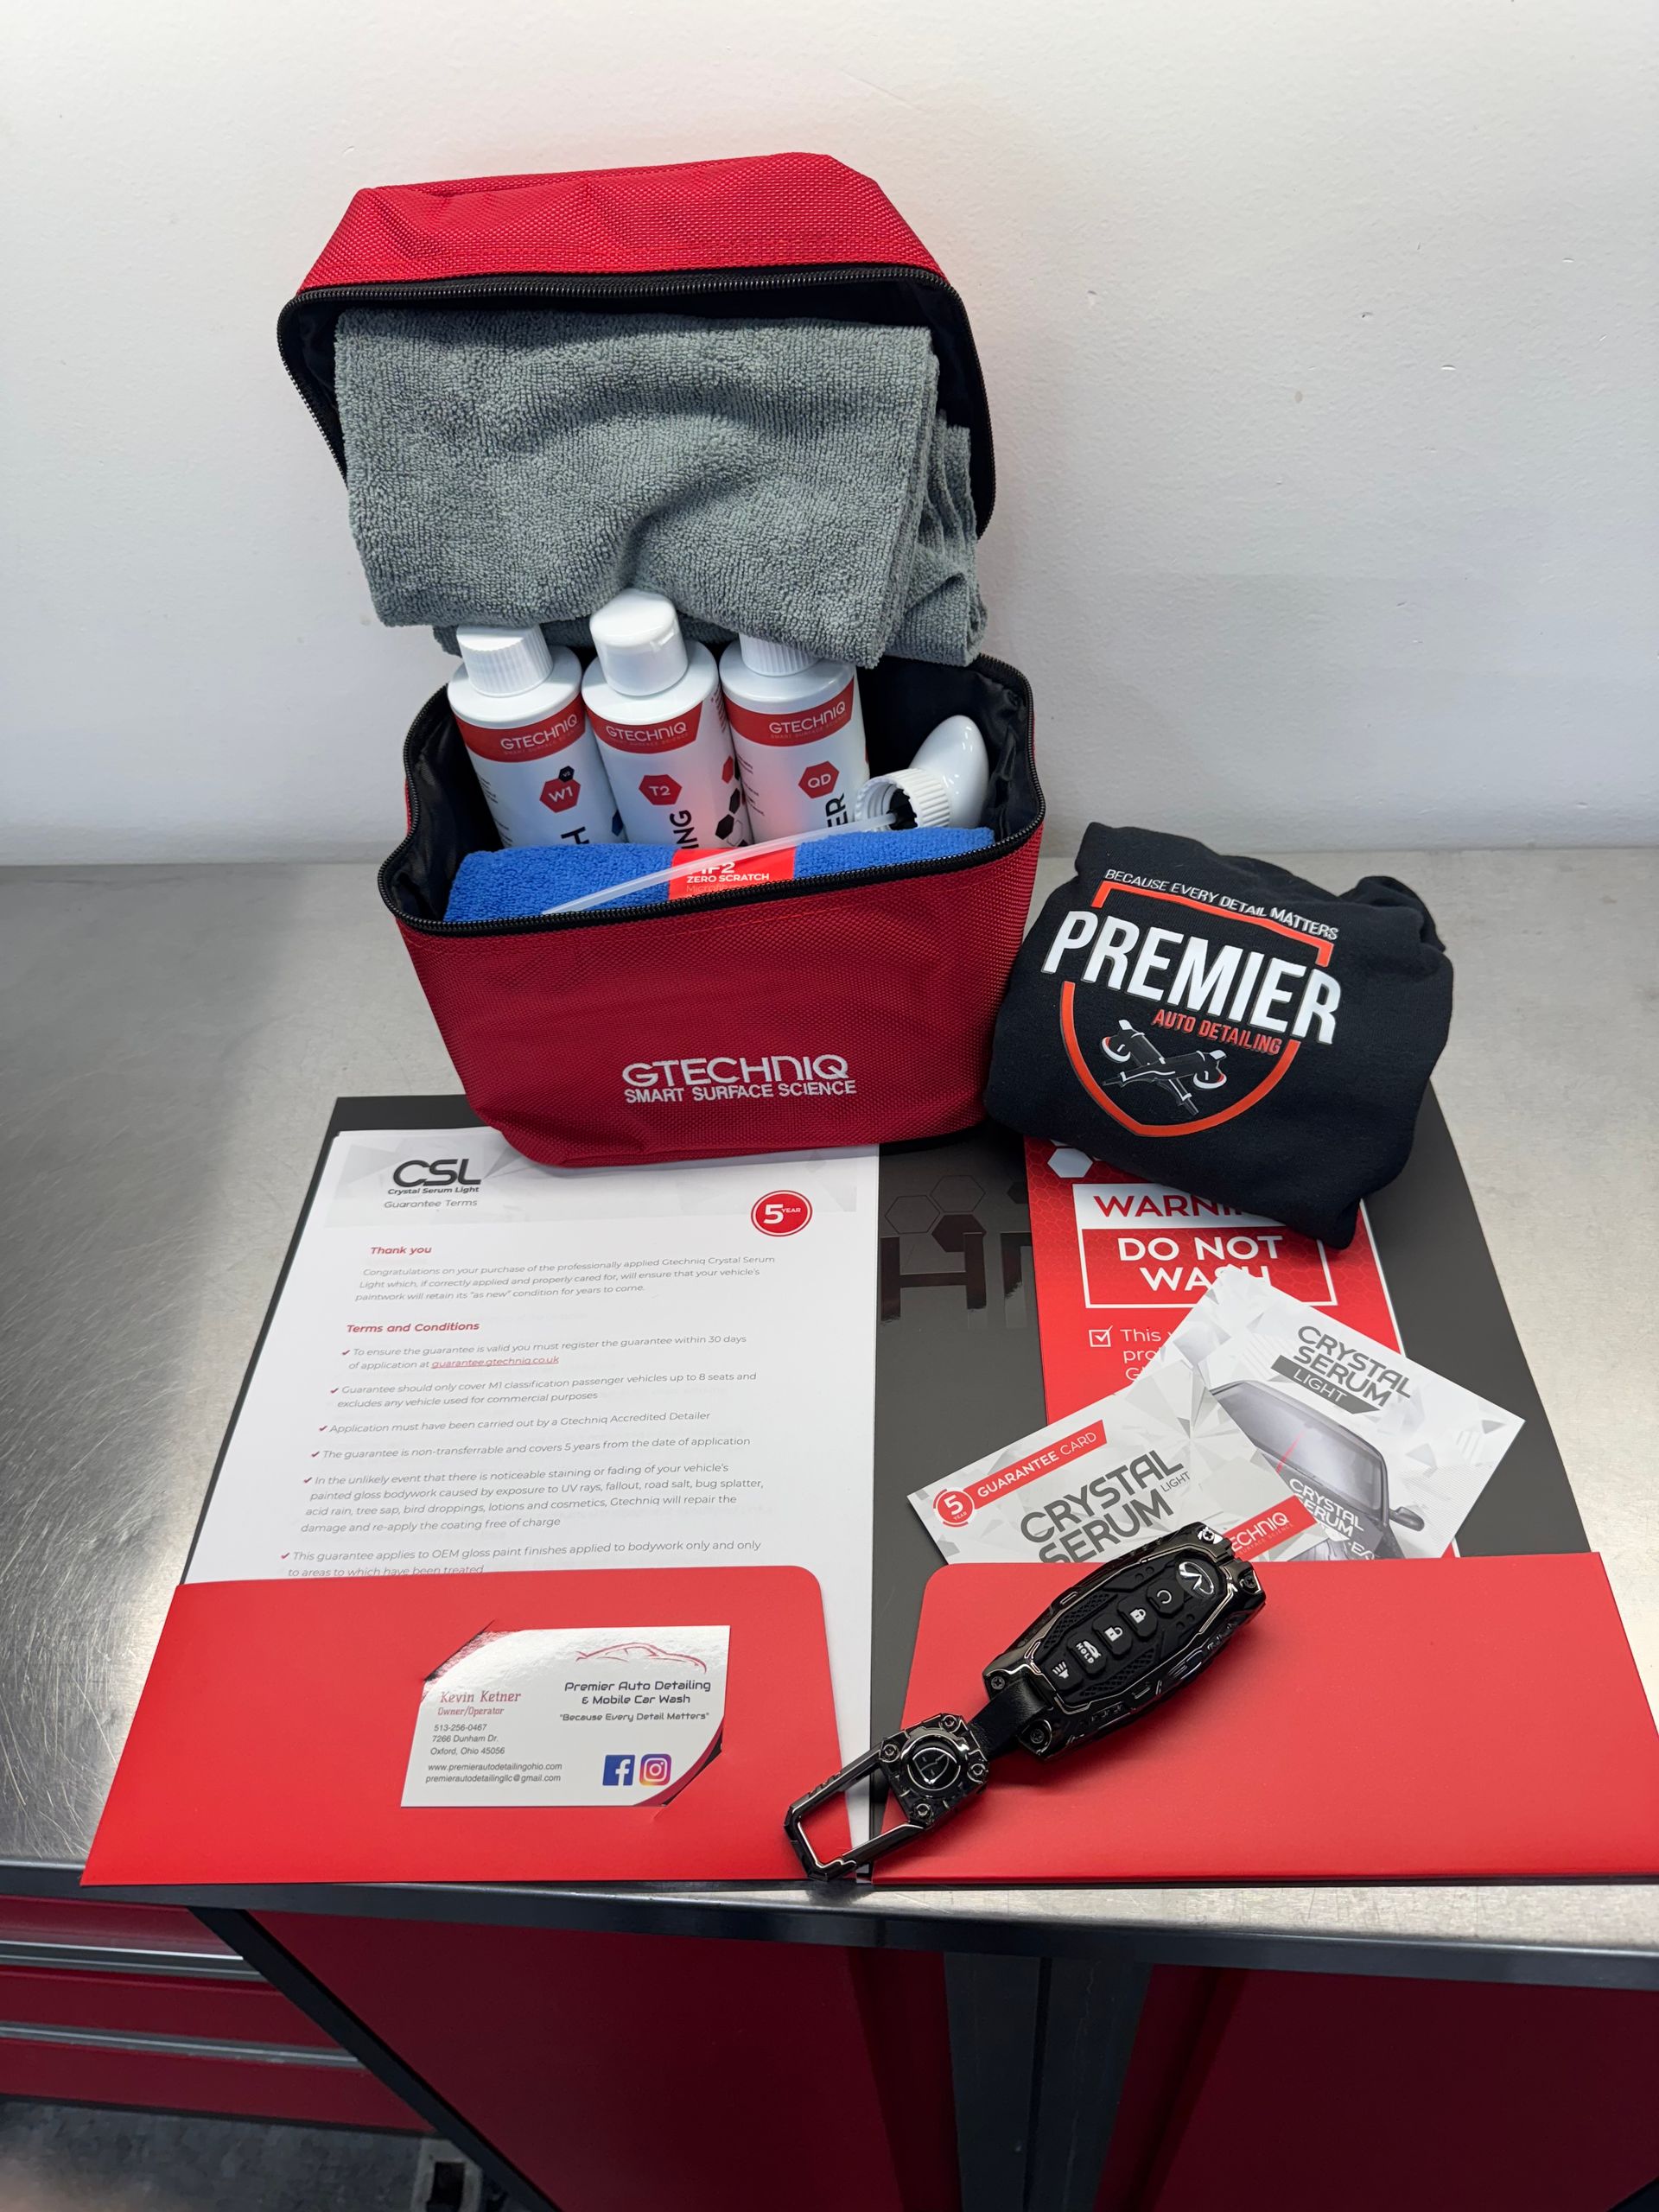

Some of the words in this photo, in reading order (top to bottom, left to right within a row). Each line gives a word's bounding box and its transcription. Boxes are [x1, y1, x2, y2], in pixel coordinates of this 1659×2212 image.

[769, 701, 845, 734] GTECHNIQ
[500, 714, 578, 750] GTECHNIQ
[606, 721, 687, 742] GTECHNIQ
[649, 785, 671, 796] T2
[808, 773, 831, 788] QD
[549, 786, 574, 803] W1
[686, 874, 716, 884] ZERO
[719, 873, 770, 882] SCRATCH
[1104, 868, 1170, 891] BECAUSE
[1171, 882, 1218, 903] EVERY
[1219, 895, 1268, 918] DETAIL
[1270, 907, 1339, 942] MATTERS
[1041, 911, 1341, 1045] PREMIER
[1152, 1008, 1197, 1034] AUTO
[1198, 1020, 1282, 1055] DETAILING
[622, 1054, 849, 1087] GTECHNIQ
[624, 1087, 684, 1103] SMART
[691, 1084, 773, 1103] SURFACE
[778, 1080, 857, 1097] SCIENCE
[393, 1159, 481, 1187] CSL
[387, 1187, 421, 1196] Crystal
[763, 1204, 784, 1224] 5
[1093, 1195, 1242, 1217] WARNI
[409, 1247, 432, 1255] you
[1117, 1237, 1179, 1262] DO
[1194, 1236, 1283, 1260] NOT
[363, 1268, 440, 1277] Congratulations
[480, 1266, 525, 1274] purchase
[556, 1261, 622, 1272] professionally
[623, 1259, 659, 1268] applied
[708, 1256, 741, 1265] Crystal
[386, 1323, 411, 1332] and
[414, 1322, 480, 1332] Conditions
[1120, 1328, 1161, 1342] This
[422, 1347, 474, 1356] guarantee
[486, 1344, 511, 1352] valid
[511, 1344, 531, 1353] you
[561, 1341, 599, 1351] register
[620, 1338, 672, 1348] guarantee
[708, 1335, 721, 1344] 30
[722, 1335, 747, 1344] days
[348, 1361, 360, 1370] of
[360, 1361, 417, 1370] application
[1298, 1325, 1411, 1399] CRYSTAL
[1293, 1345, 1392, 1408] SERUM
[1293, 1369, 1347, 1402] LIGHT
[337, 1399, 383, 1408] excludes
[405, 1397, 442, 1406] vehicle
[443, 1395, 468, 1404] used
[486, 1394, 549, 1403] commercial
[550, 1393, 598, 1402] purposes
[328, 1424, 389, 1433] Application
[448, 1421, 475, 1429] been
[477, 1420, 514, 1428] carried
[536, 1418, 550, 1427] by
[560, 1416, 607, 1425] Gtechniq
[609, 1412, 666, 1423] Accredited
[669, 1411, 710, 1420] Detailer
[344, 1450, 399, 1460] guarantee
[400, 1448, 410, 1457] is
[411, 1446, 504, 1456] non-transferrable
[505, 1445, 527, 1453] and
[563, 1442, 571, 1451] 5
[572, 1443, 601, 1452] years
[632, 1439, 650, 1447] the
[652, 1438, 676, 1446] date
[677, 1437, 690, 1446] of
[690, 1437, 750, 1446] application
[976, 1450, 1059, 1498] GUARANTEE
[1059, 1432, 1097, 1456] CARD
[1160, 1471, 1191, 1492] LIGHT
[944, 1494, 964, 1516] 5
[1020, 1450, 1185, 1543] CRYSTAL
[1289, 1478, 1364, 1532] CRYSTAL
[300, 1523, 346, 1534] damage
[348, 1522, 371, 1532] and
[372, 1522, 418, 1532] re-apply
[419, 1521, 438, 1529] the
[440, 1520, 482, 1531] coating
[485, 1519, 506, 1528] free
[509, 1517, 522, 1527] of
[522, 1517, 561, 1528] charge
[1076, 1643, 1094, 1663] HOLD
[440, 1691, 474, 1703] Kevin
[480, 1690, 522, 1703] Ketner
[564, 1681, 615, 1692] Premier
[619, 1681, 651, 1691] Auto
[654, 1680, 711, 1692] Detailing
[582, 1695, 589, 1704] &
[593, 1694, 630, 1705] Mobile
[634, 1694, 656, 1705] Car
[658, 1694, 690, 1704] Wash
[437, 1705, 505, 1717] Owner/Operator
[605, 1713, 633, 1723] Every
[636, 1713, 664, 1721] Detail
[667, 1712, 709, 1720] Matters"
[453, 1734, 487, 1743] Dunham
[488, 1734, 499, 1743] Dr.
[430, 1747, 458, 1756] Oxford,
[428, 1762, 563, 1772] www.premierautodetailingohio.com
[426, 1774, 562, 1783] premierautodetailingllc@gmail.com
